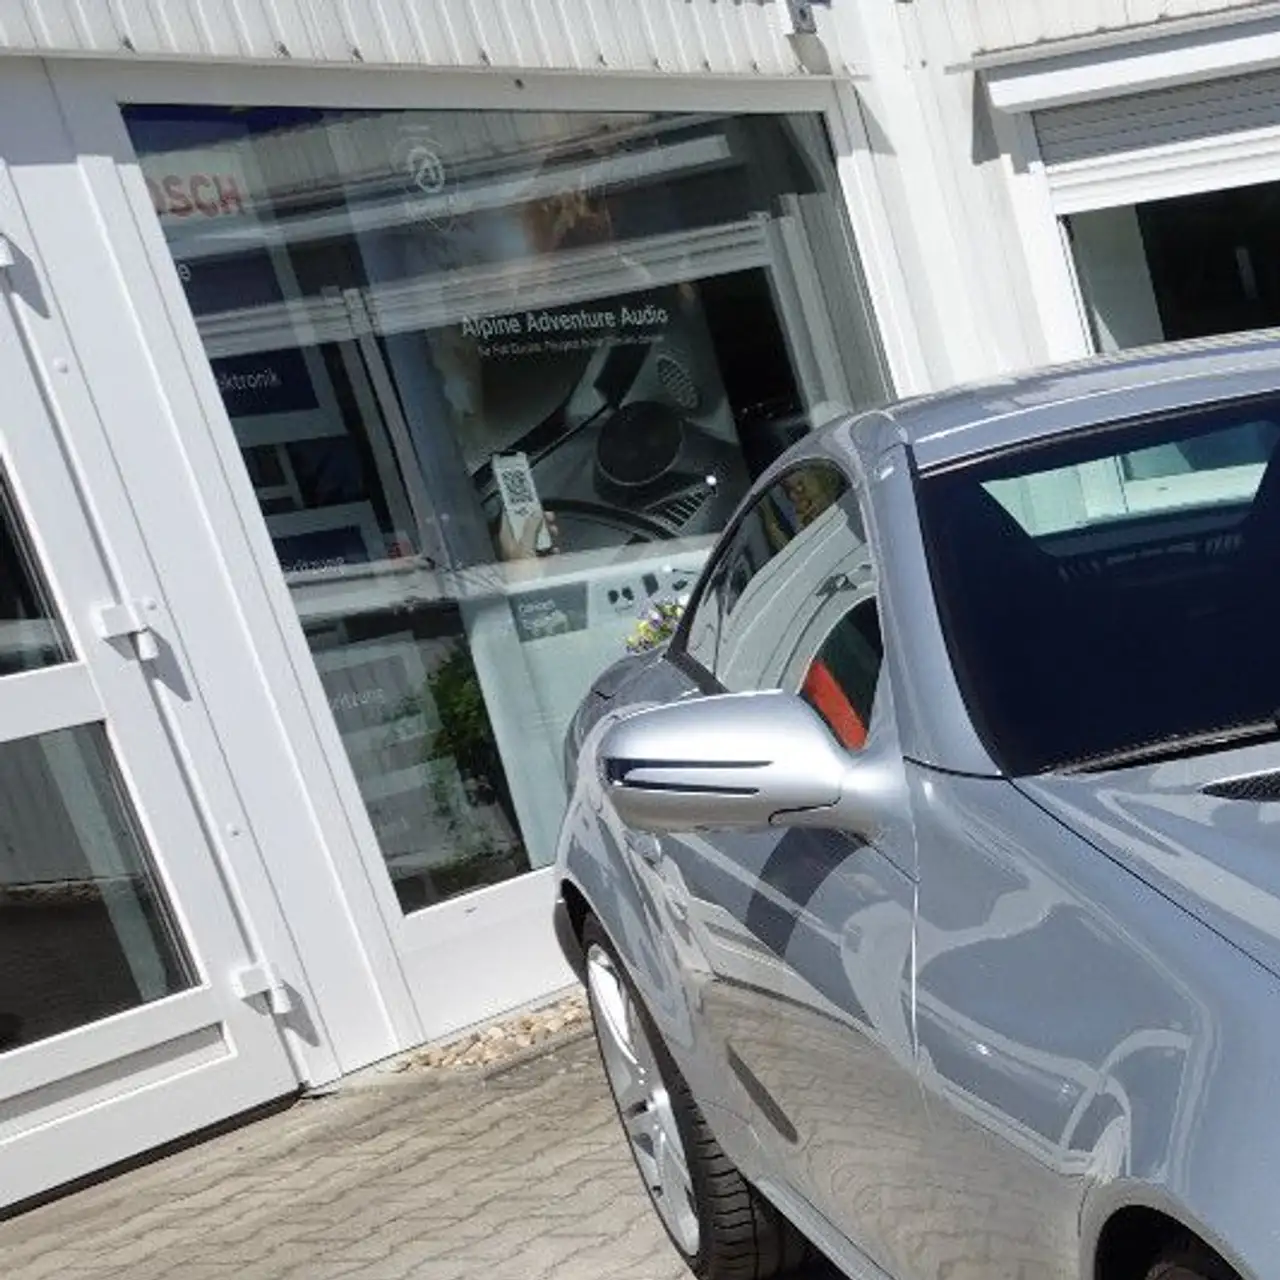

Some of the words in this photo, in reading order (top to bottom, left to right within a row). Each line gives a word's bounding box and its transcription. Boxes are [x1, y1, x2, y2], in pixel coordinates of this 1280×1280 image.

[461, 314, 521, 340] Alpine
[526, 308, 617, 333] Adventure
[620, 304, 669, 326] Audio
